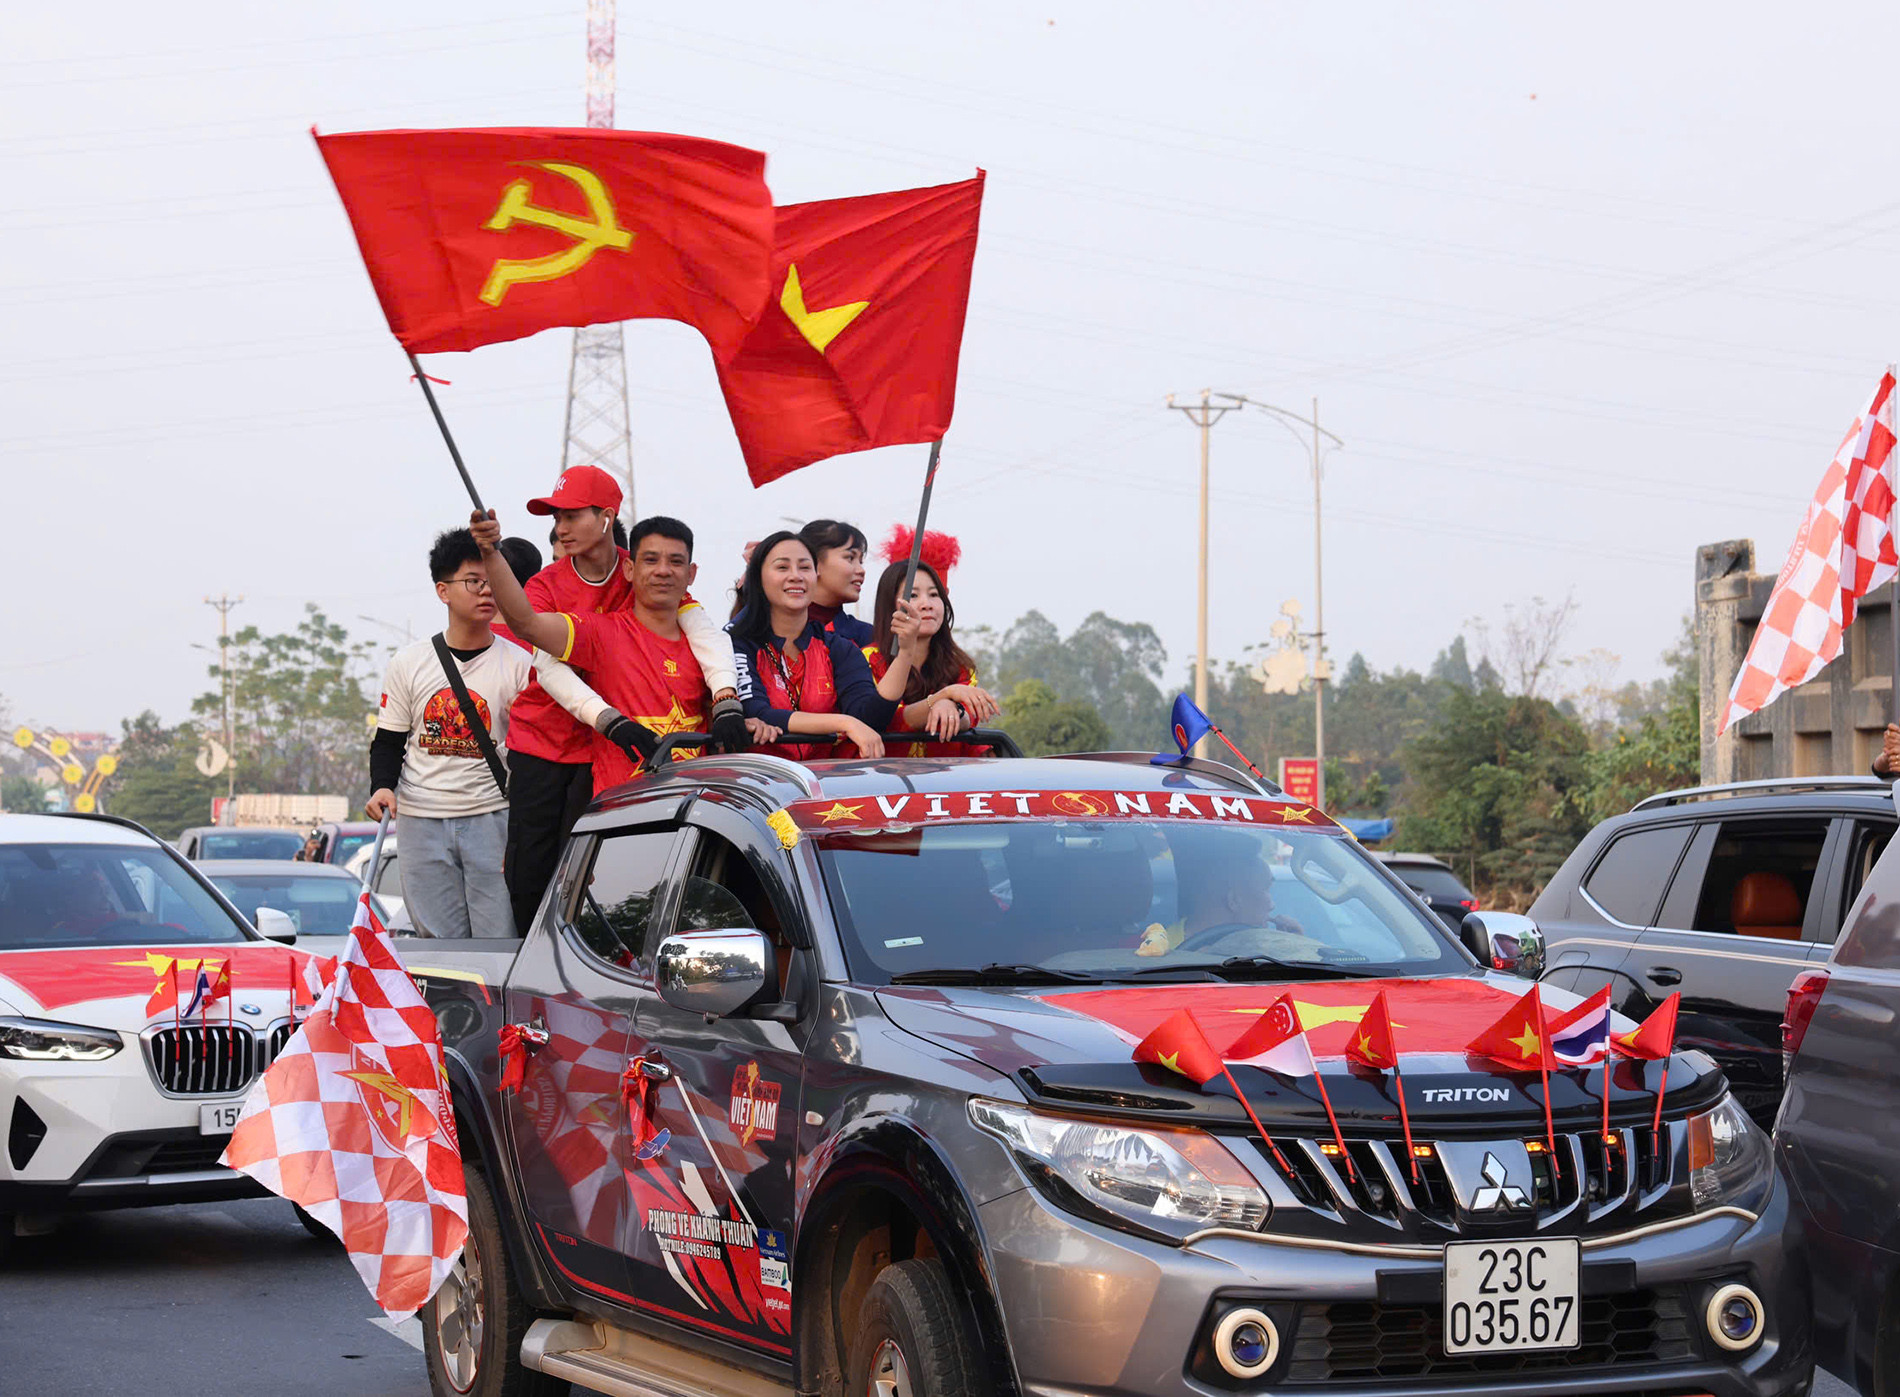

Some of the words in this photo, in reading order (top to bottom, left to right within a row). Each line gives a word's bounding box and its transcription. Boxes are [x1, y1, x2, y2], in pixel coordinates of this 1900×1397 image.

[875, 793, 1040, 818] VIET
[1113, 793, 1254, 820] NAM
[731, 1092, 752, 1131] VIỆT
[753, 1099, 777, 1130] NAM
[1422, 1088, 1510, 1102] TRITON
[648, 1205, 677, 1235] PHÒNG
[690, 1210, 721, 1242] KHÁNH
[721, 1219, 754, 1252] THUẬN
[1478, 1247, 1547, 1294] 23C
[1450, 1296, 1574, 1346] 035.67
